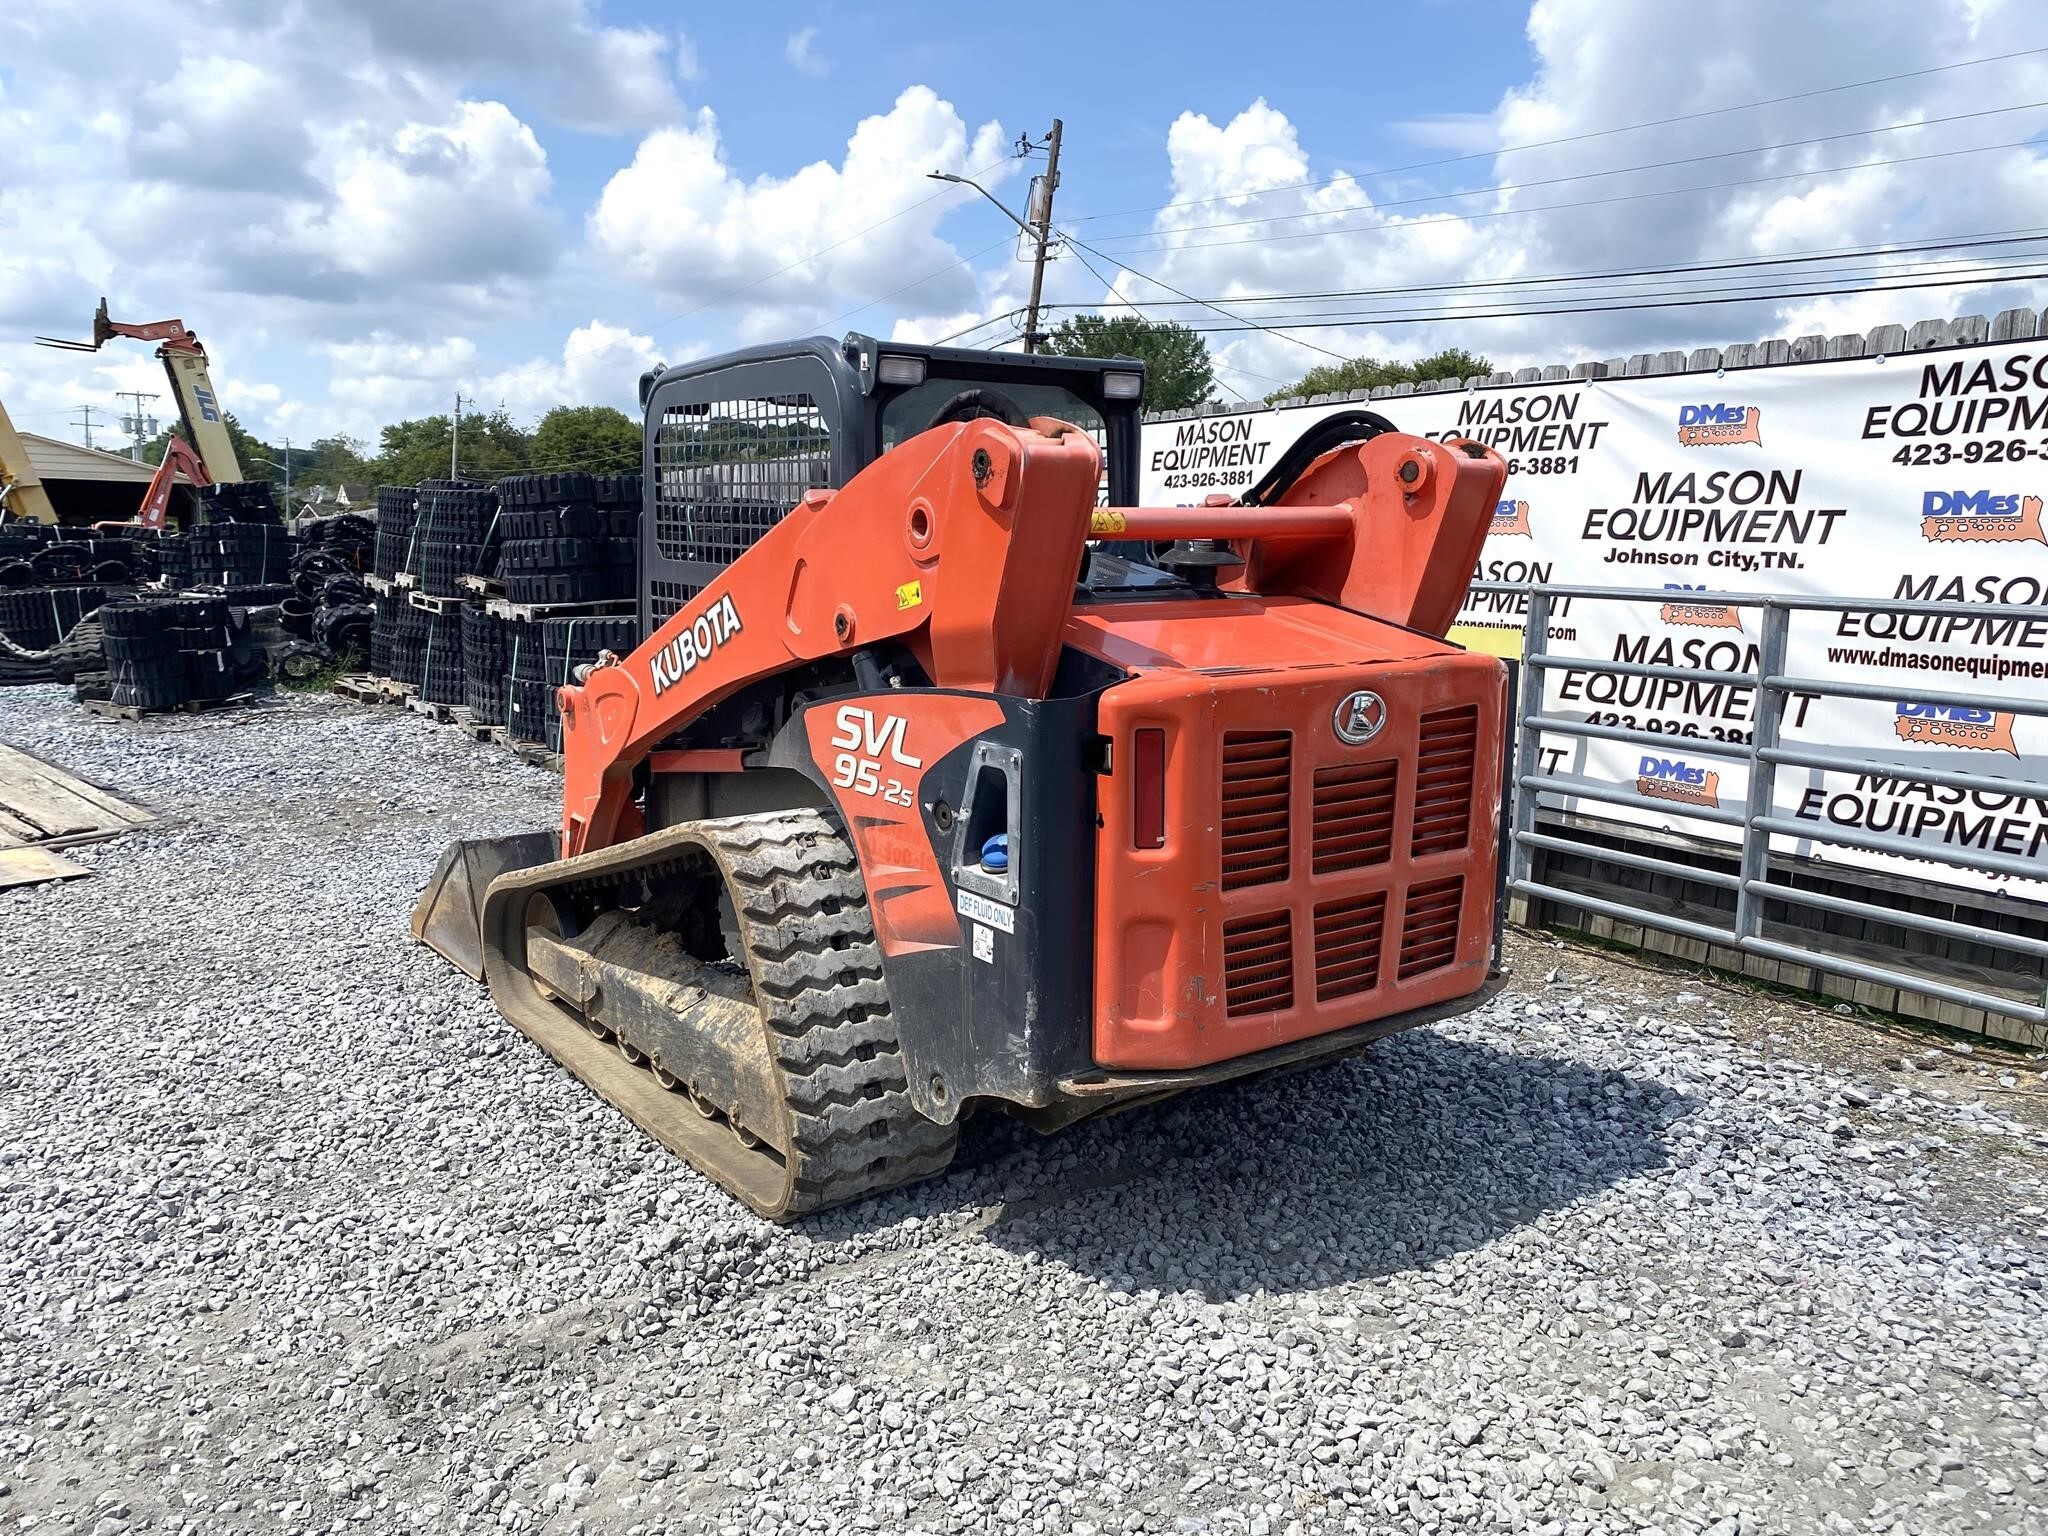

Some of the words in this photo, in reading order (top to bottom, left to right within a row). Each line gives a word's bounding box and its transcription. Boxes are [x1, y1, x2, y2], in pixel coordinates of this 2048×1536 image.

[192, 384, 221, 423] JLG
[1457, 393, 1580, 426] MASON
[1175, 418, 1252, 447] MASON
[1151, 441, 1271, 472] EQUIPMENT
[1507, 456, 1579, 476] 6-3881
[1164, 470, 1253, 489] 423-926-3881
[1632, 469, 1802, 505] MASON
[1581, 508, 1847, 545] EQUIPMENT
[1472, 560, 1553, 584] ASON
[1604, 548, 1698, 566] Johnson
[1893, 574, 2048, 606] MASO
[650, 593, 742, 697] KUBOTA
[1827, 646, 2048, 681] www.dmasonequipme
[1559, 670, 1822, 728] EQUIPMET
[831, 704, 923, 770] SVL
[1585, 711, 1753, 745] 423-926-38
[960, 894, 972, 912] DEF
[973, 899, 993, 920] FLUID
[993, 907, 1012, 928] ONLY
